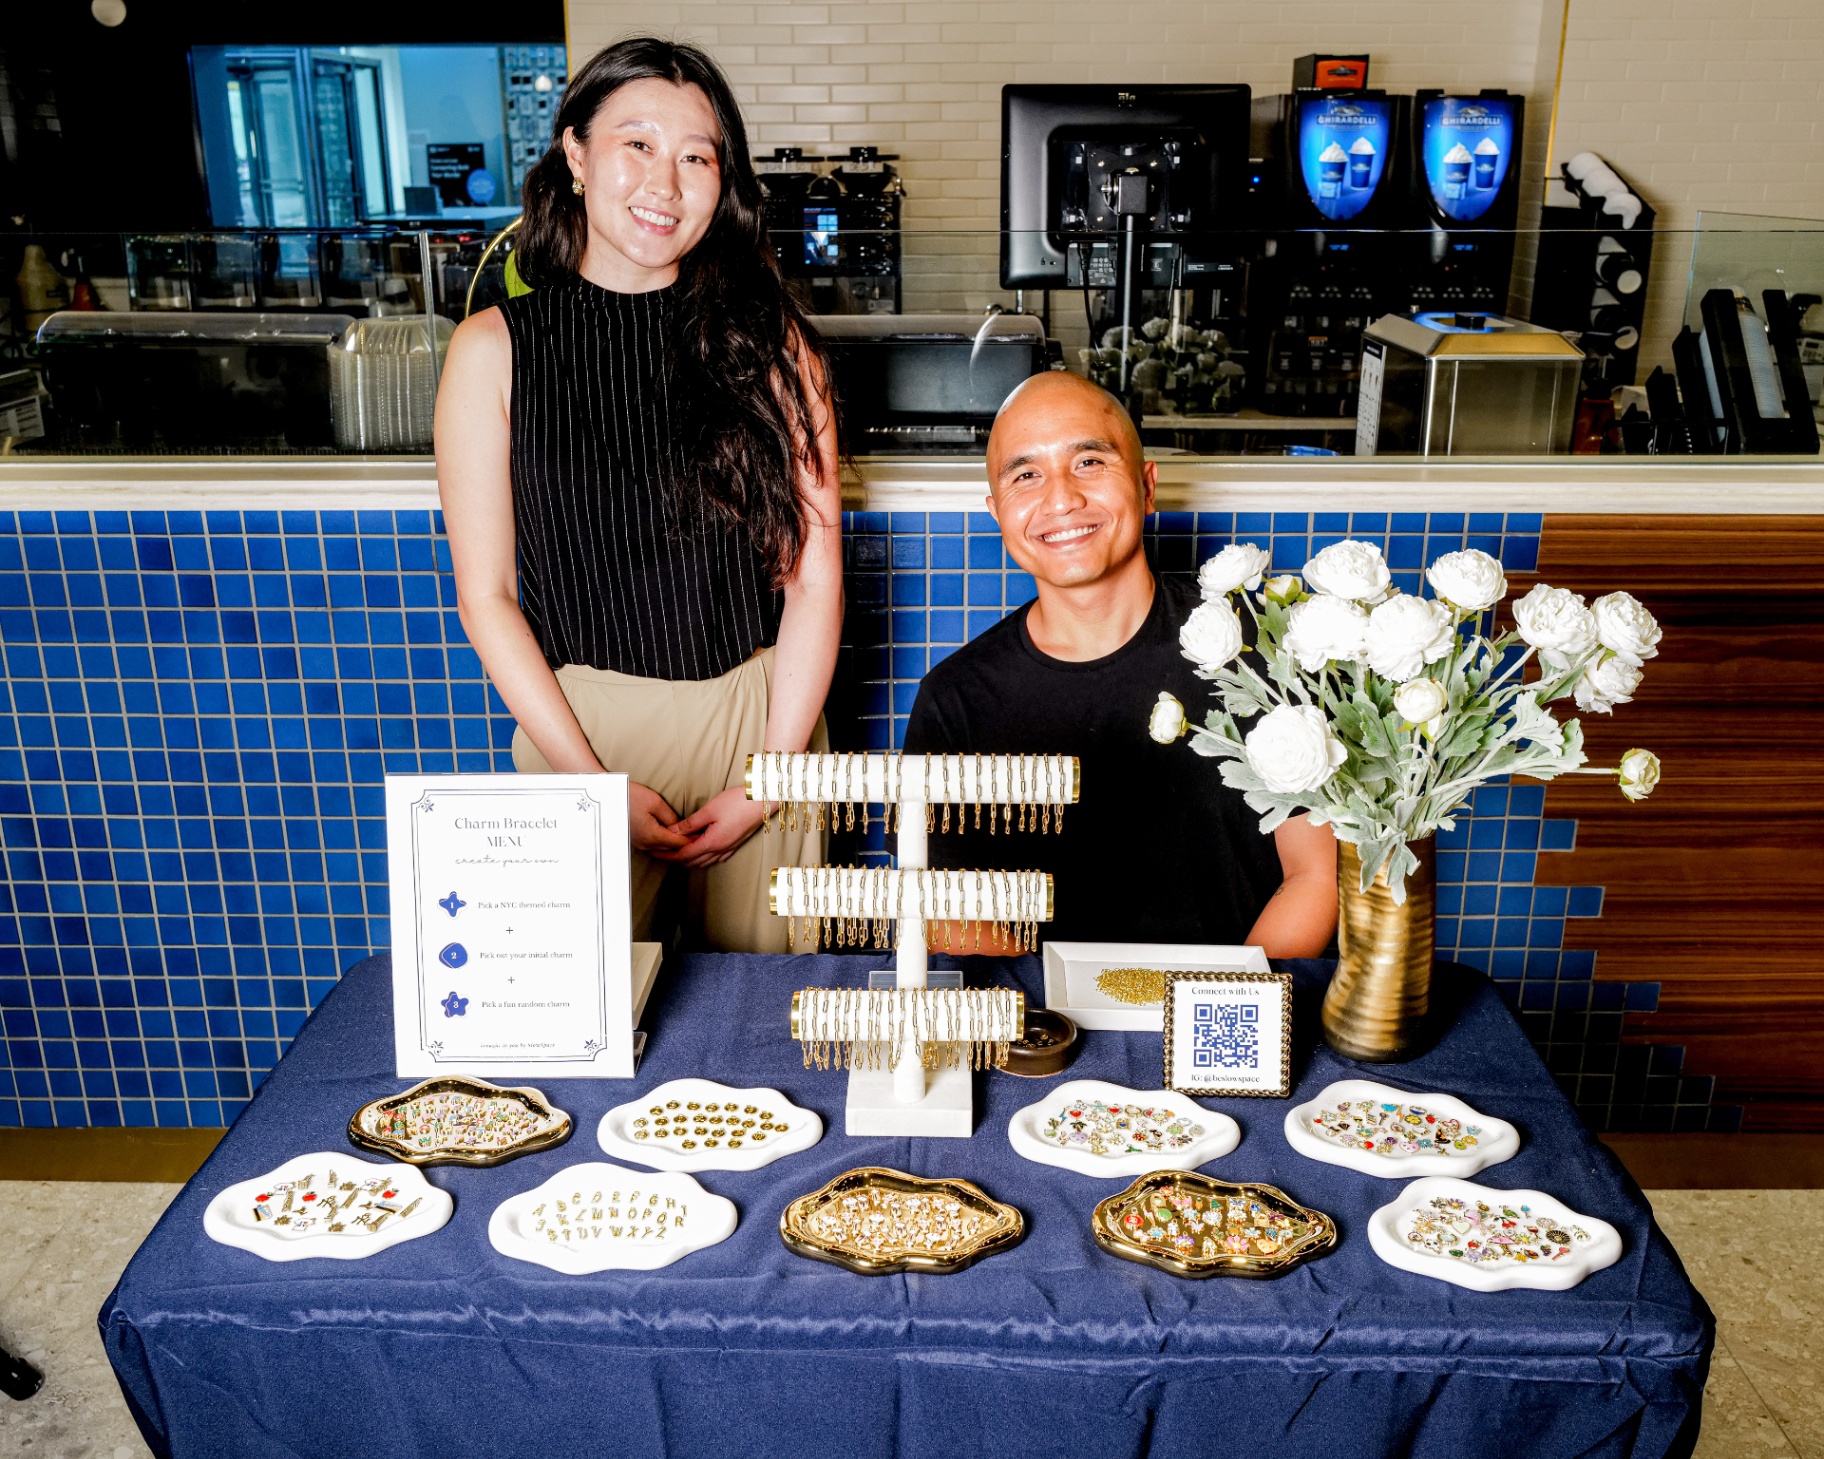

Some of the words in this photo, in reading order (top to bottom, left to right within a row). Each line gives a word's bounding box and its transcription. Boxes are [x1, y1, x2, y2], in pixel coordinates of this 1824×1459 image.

[1317, 115, 1377, 125] GHIRARDELLI
[1441, 116, 1502, 126] GHIRARDELLI
[454, 817, 500, 829] Charm
[503, 817, 557, 829] Bracelet
[487, 836, 526, 847] MENU
[478, 901, 493, 909] Pick
[500, 901, 518, 909] NYC
[518, 901, 546, 909] themed
[547, 900, 571, 908] charm
[479, 951, 495, 959] Pick
[509, 953, 527, 961] your
[528, 951, 549, 959] initial
[549, 950, 573, 959] charm
[1191, 986, 1227, 996] Connect
[1228, 986, 1247, 996] with
[1248, 986, 1260, 996] Us
[481, 1000, 497, 1008] Pick
[503, 1000, 517, 1008] fun
[517, 1000, 546, 1008] random
[547, 1000, 571, 1008] charm
[1191, 1073, 1203, 1082] IG:
